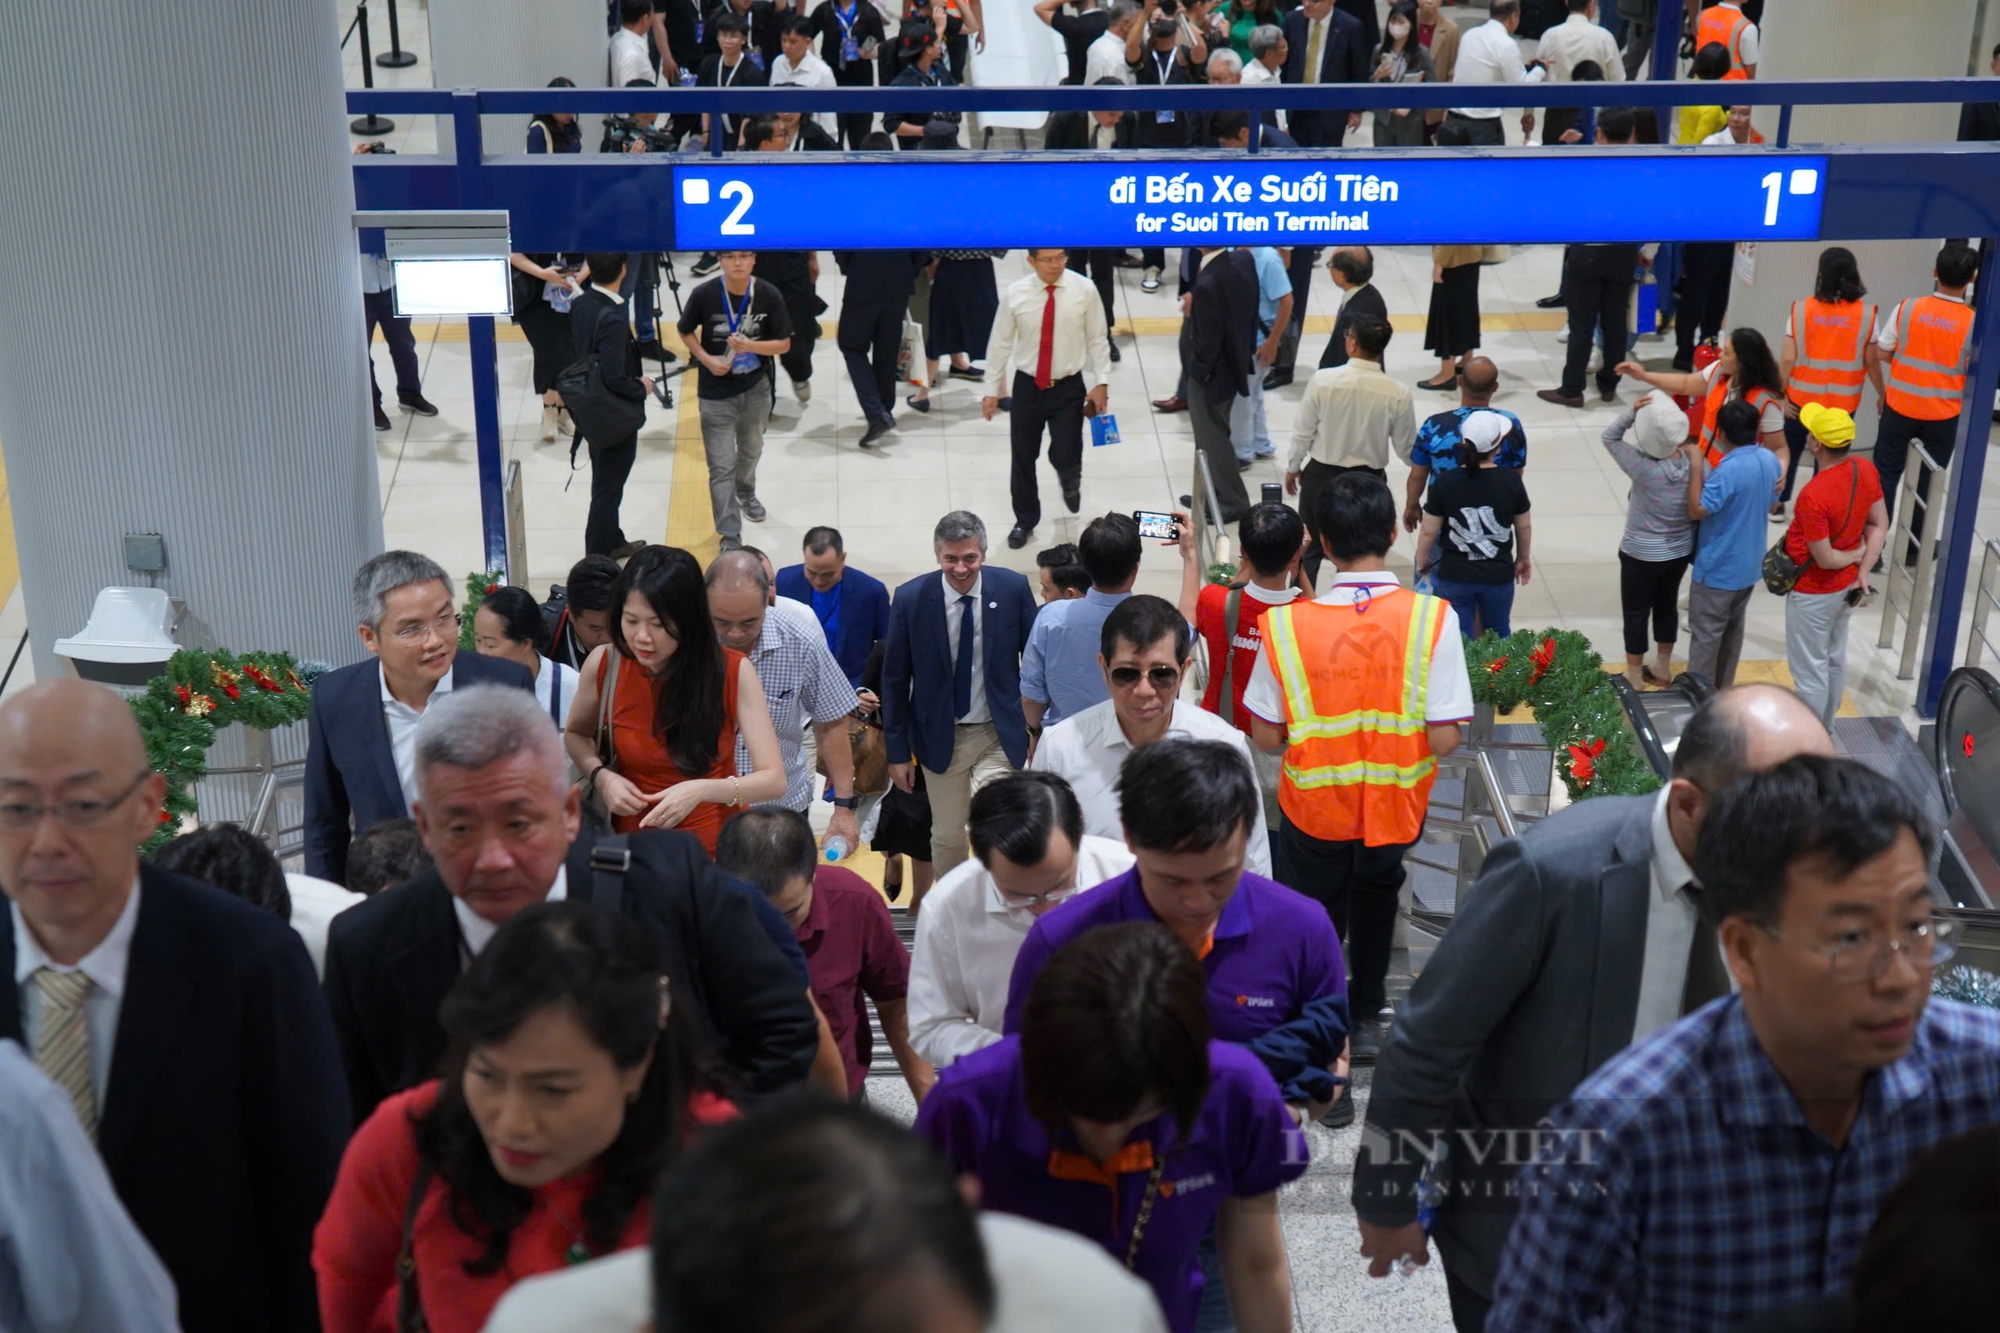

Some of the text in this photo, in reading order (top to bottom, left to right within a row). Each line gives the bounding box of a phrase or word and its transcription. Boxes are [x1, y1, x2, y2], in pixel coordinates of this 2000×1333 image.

[719, 180, 755, 236] 2
[1109, 171, 1399, 204] đi Bến Xe Suối Tiên
[1761, 171, 1782, 226] 1
[1136, 210, 1370, 232] for Suoi Tien Terminal
